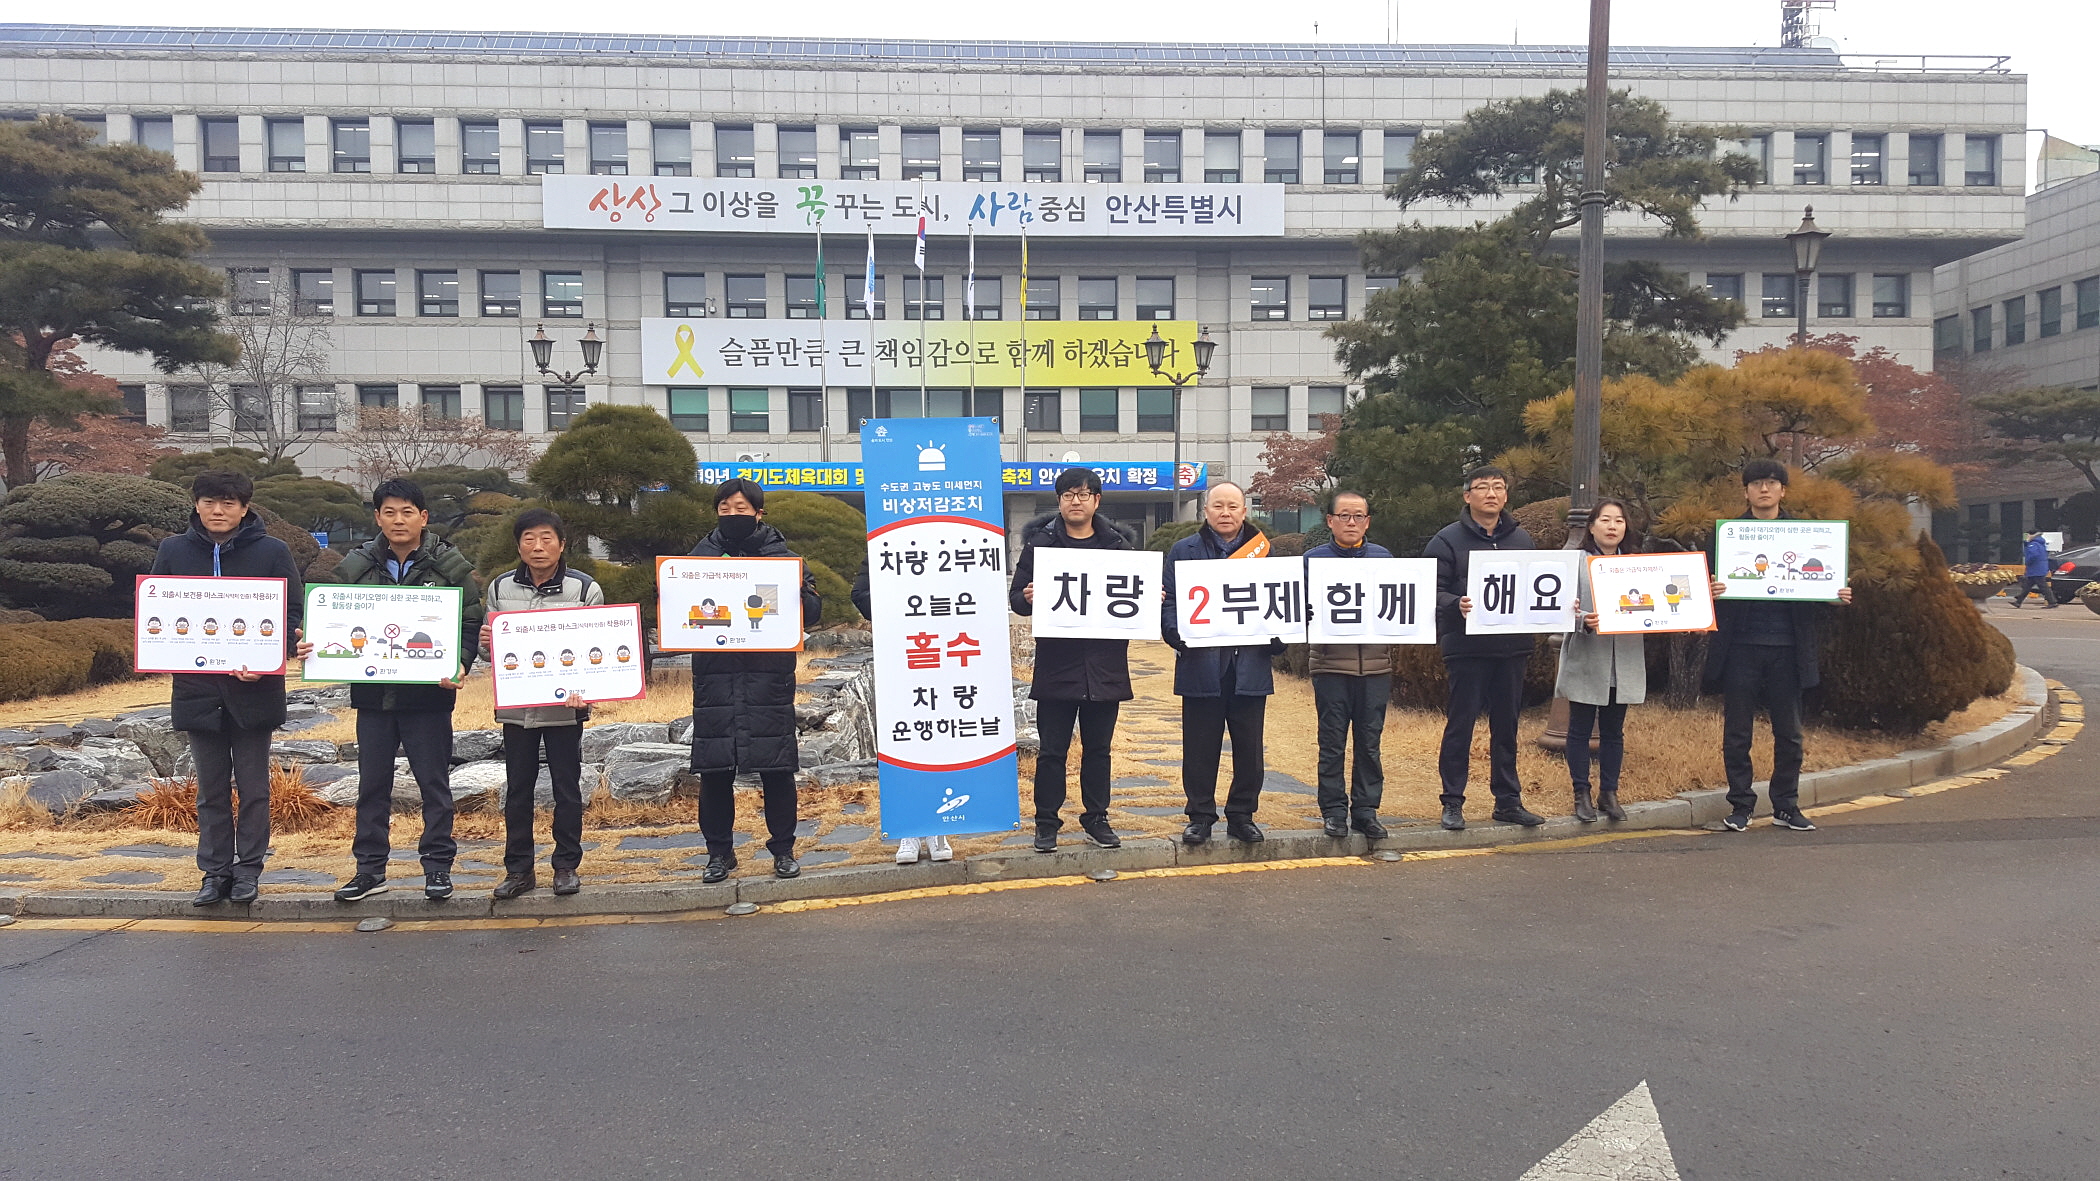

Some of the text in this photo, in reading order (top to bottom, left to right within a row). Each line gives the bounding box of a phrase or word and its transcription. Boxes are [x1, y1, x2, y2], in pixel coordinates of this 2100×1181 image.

[588, 182, 662, 223] 상상
[669, 191, 694, 215] 그
[703, 190, 779, 219] 이상을
[892, 194, 949, 223] 도시,
[1106, 194, 1242, 225] 안산특별시
[719, 336, 829, 368] 슬픔만큼
[838, 339, 866, 368] 큰
[874, 337, 1000, 368] 책임감으로
[1006, 338, 1055, 369] 함께
[696, 467, 730, 485] 19년
[737, 467, 848, 486] 경기도체육대회
[880, 480, 982, 493] 수도권 고농도 미세먼지
[1127, 467, 1157, 485] 확정
[882, 496, 983, 514] 비상저감조치
[1727, 527, 1734, 536] 3
[669, 565, 675, 576] 1
[681, 571, 701, 580] 외출은
[722, 572, 748, 580] 자제하기
[880, 547, 1000, 575] 차량 2부제
[149, 584, 156, 595] 2
[162, 591, 182, 599] 외출시
[318, 593, 326, 604] 3
[1051, 571, 1144, 618] 차량
[1188, 580, 1302, 625] 2부제
[1326, 583, 1416, 625] 함께
[1483, 573, 1562, 615] 해요
[904, 592, 976, 617] 오늘은
[502, 621, 510, 632] 2
[906, 631, 981, 669] 홀수
[892, 716, 1001, 741] 운행하는날
